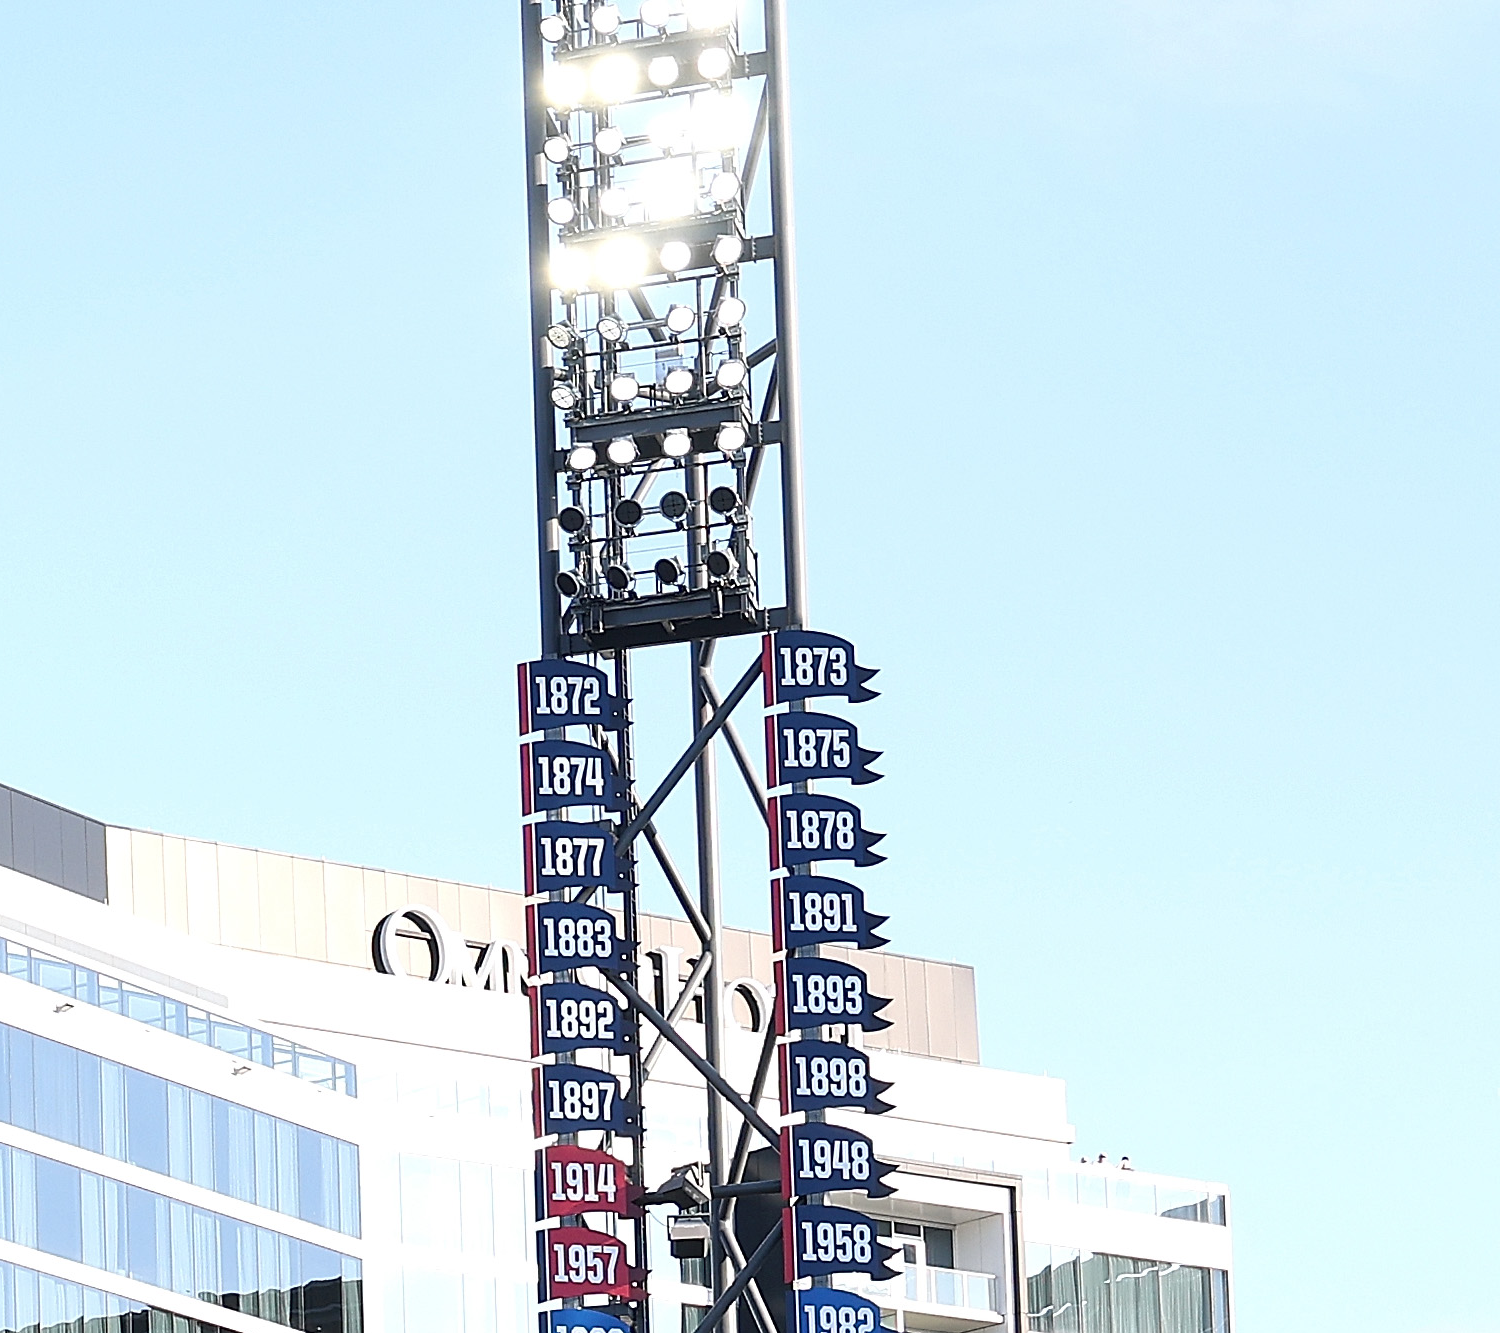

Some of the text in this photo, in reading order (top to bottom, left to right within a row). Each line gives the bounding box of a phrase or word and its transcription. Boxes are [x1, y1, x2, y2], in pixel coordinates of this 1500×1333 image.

[780, 647, 848, 687] 1873
[535, 676, 601, 716] 1872
[783, 728, 851, 768] 1875
[537, 756, 605, 796] 1874
[786, 810, 855, 850] 1878
[540, 837, 605, 876] 1877
[789, 892, 857, 932] 1891
[542, 918, 612, 958] 1883
[792, 974, 863, 1015] 1893
[545, 999, 615, 1040] 1892
[795, 1057, 867, 1098] 1898
[548, 1079, 615, 1121] 1897
[798, 1139, 870, 1180] 1948
[551, 1161, 616, 1203] 1914
[802, 1221, 872, 1263] 1958
[553, 1243, 619, 1284] 1957
